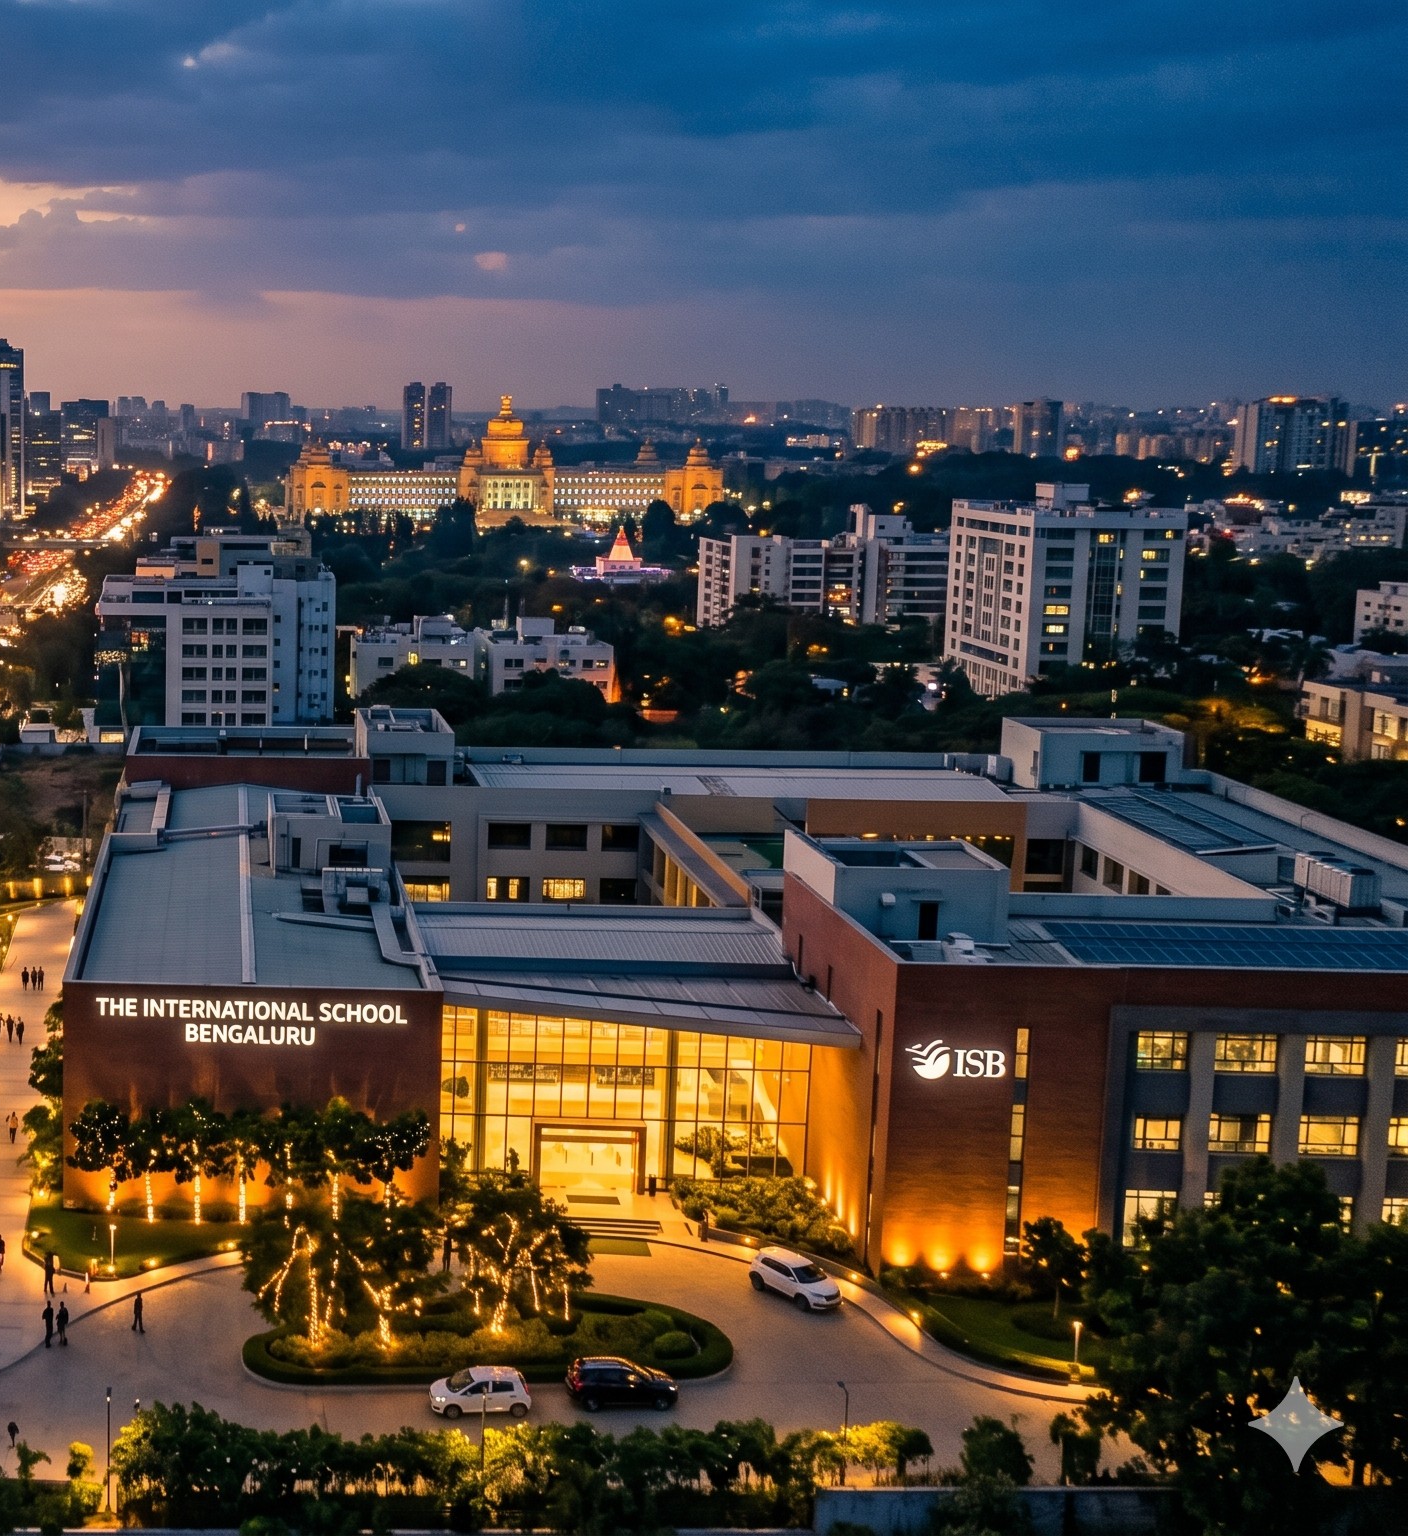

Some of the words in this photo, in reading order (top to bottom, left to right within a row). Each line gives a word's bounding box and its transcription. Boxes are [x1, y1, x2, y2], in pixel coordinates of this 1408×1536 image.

[95, 997, 138, 1017] THE
[143, 998, 315, 1022] INTERNATIONAL
[318, 1002, 408, 1025] SCHOOL
[185, 1022, 316, 1046] BENGALURU
[952, 1049, 1007, 1078] ISB
